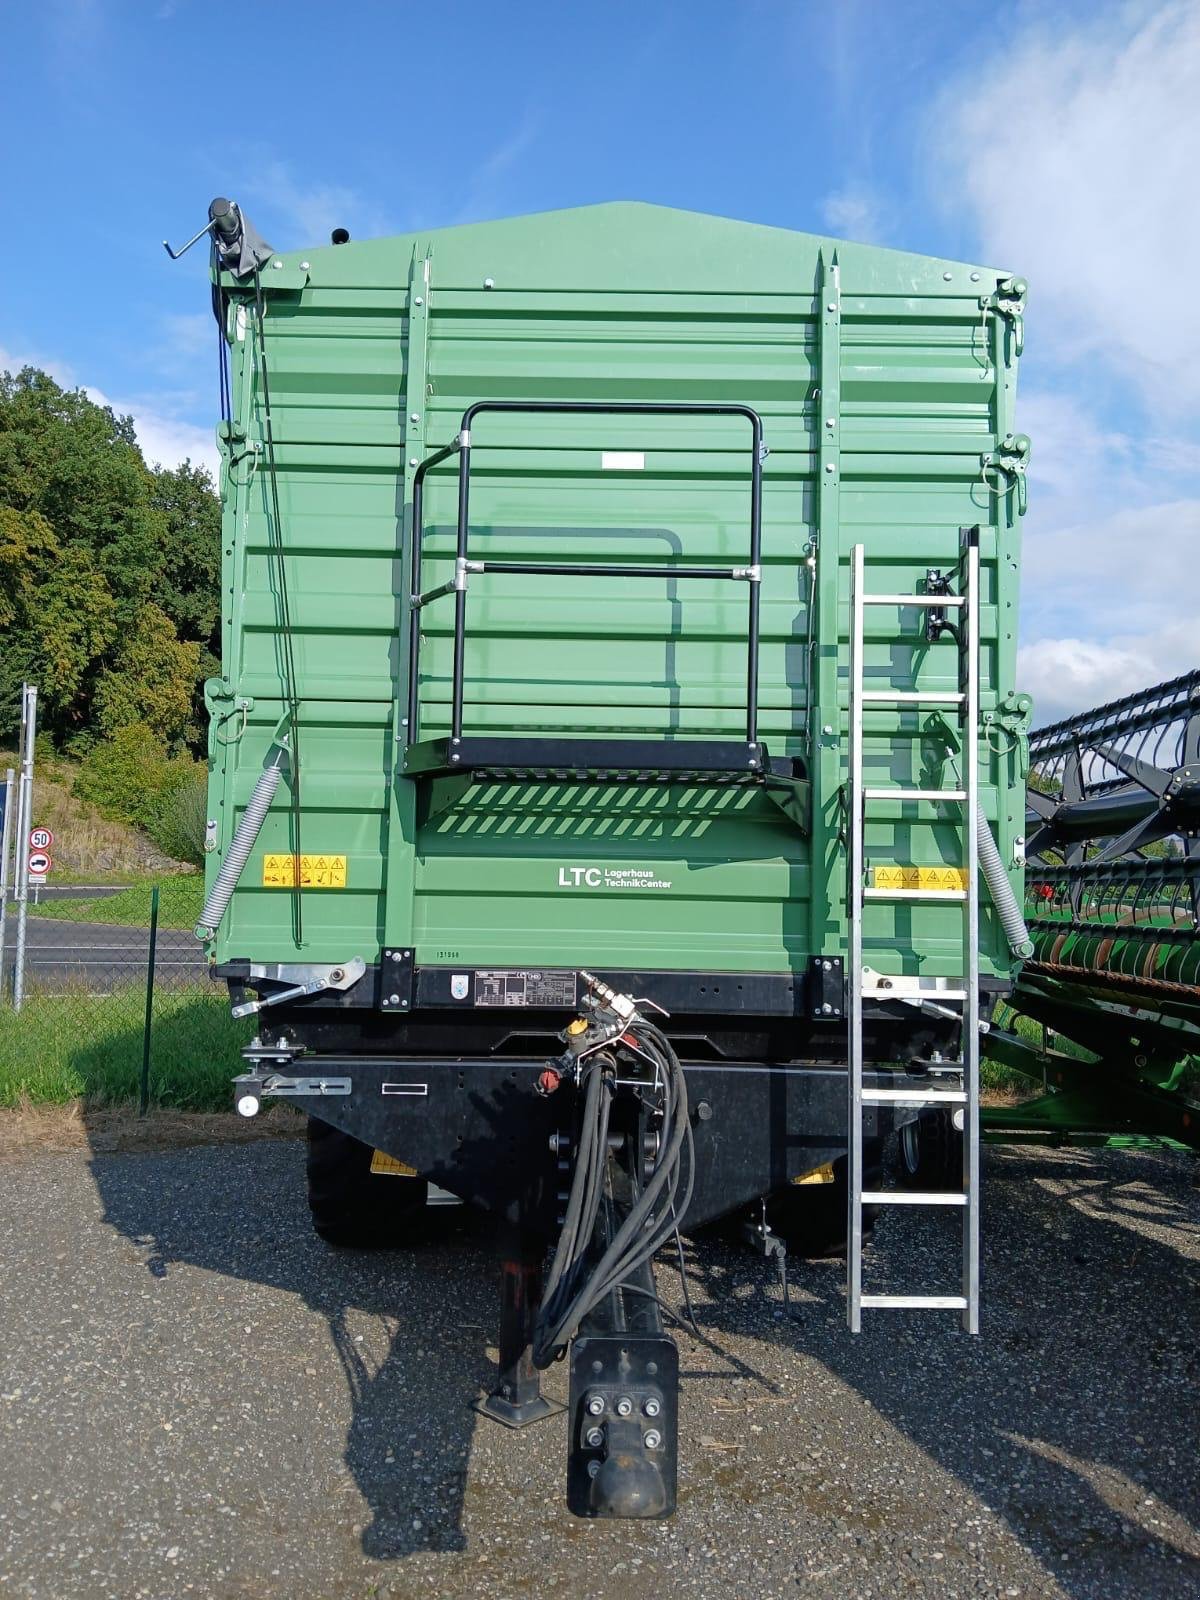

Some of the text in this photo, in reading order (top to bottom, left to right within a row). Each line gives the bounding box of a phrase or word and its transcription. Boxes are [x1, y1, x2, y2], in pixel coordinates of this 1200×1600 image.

[34, 833, 47, 845] 50
[558, 867, 602, 886] LTC
[604, 869, 654, 879] Lagerhaus
[604, 878, 673, 888] TechnikCenter
